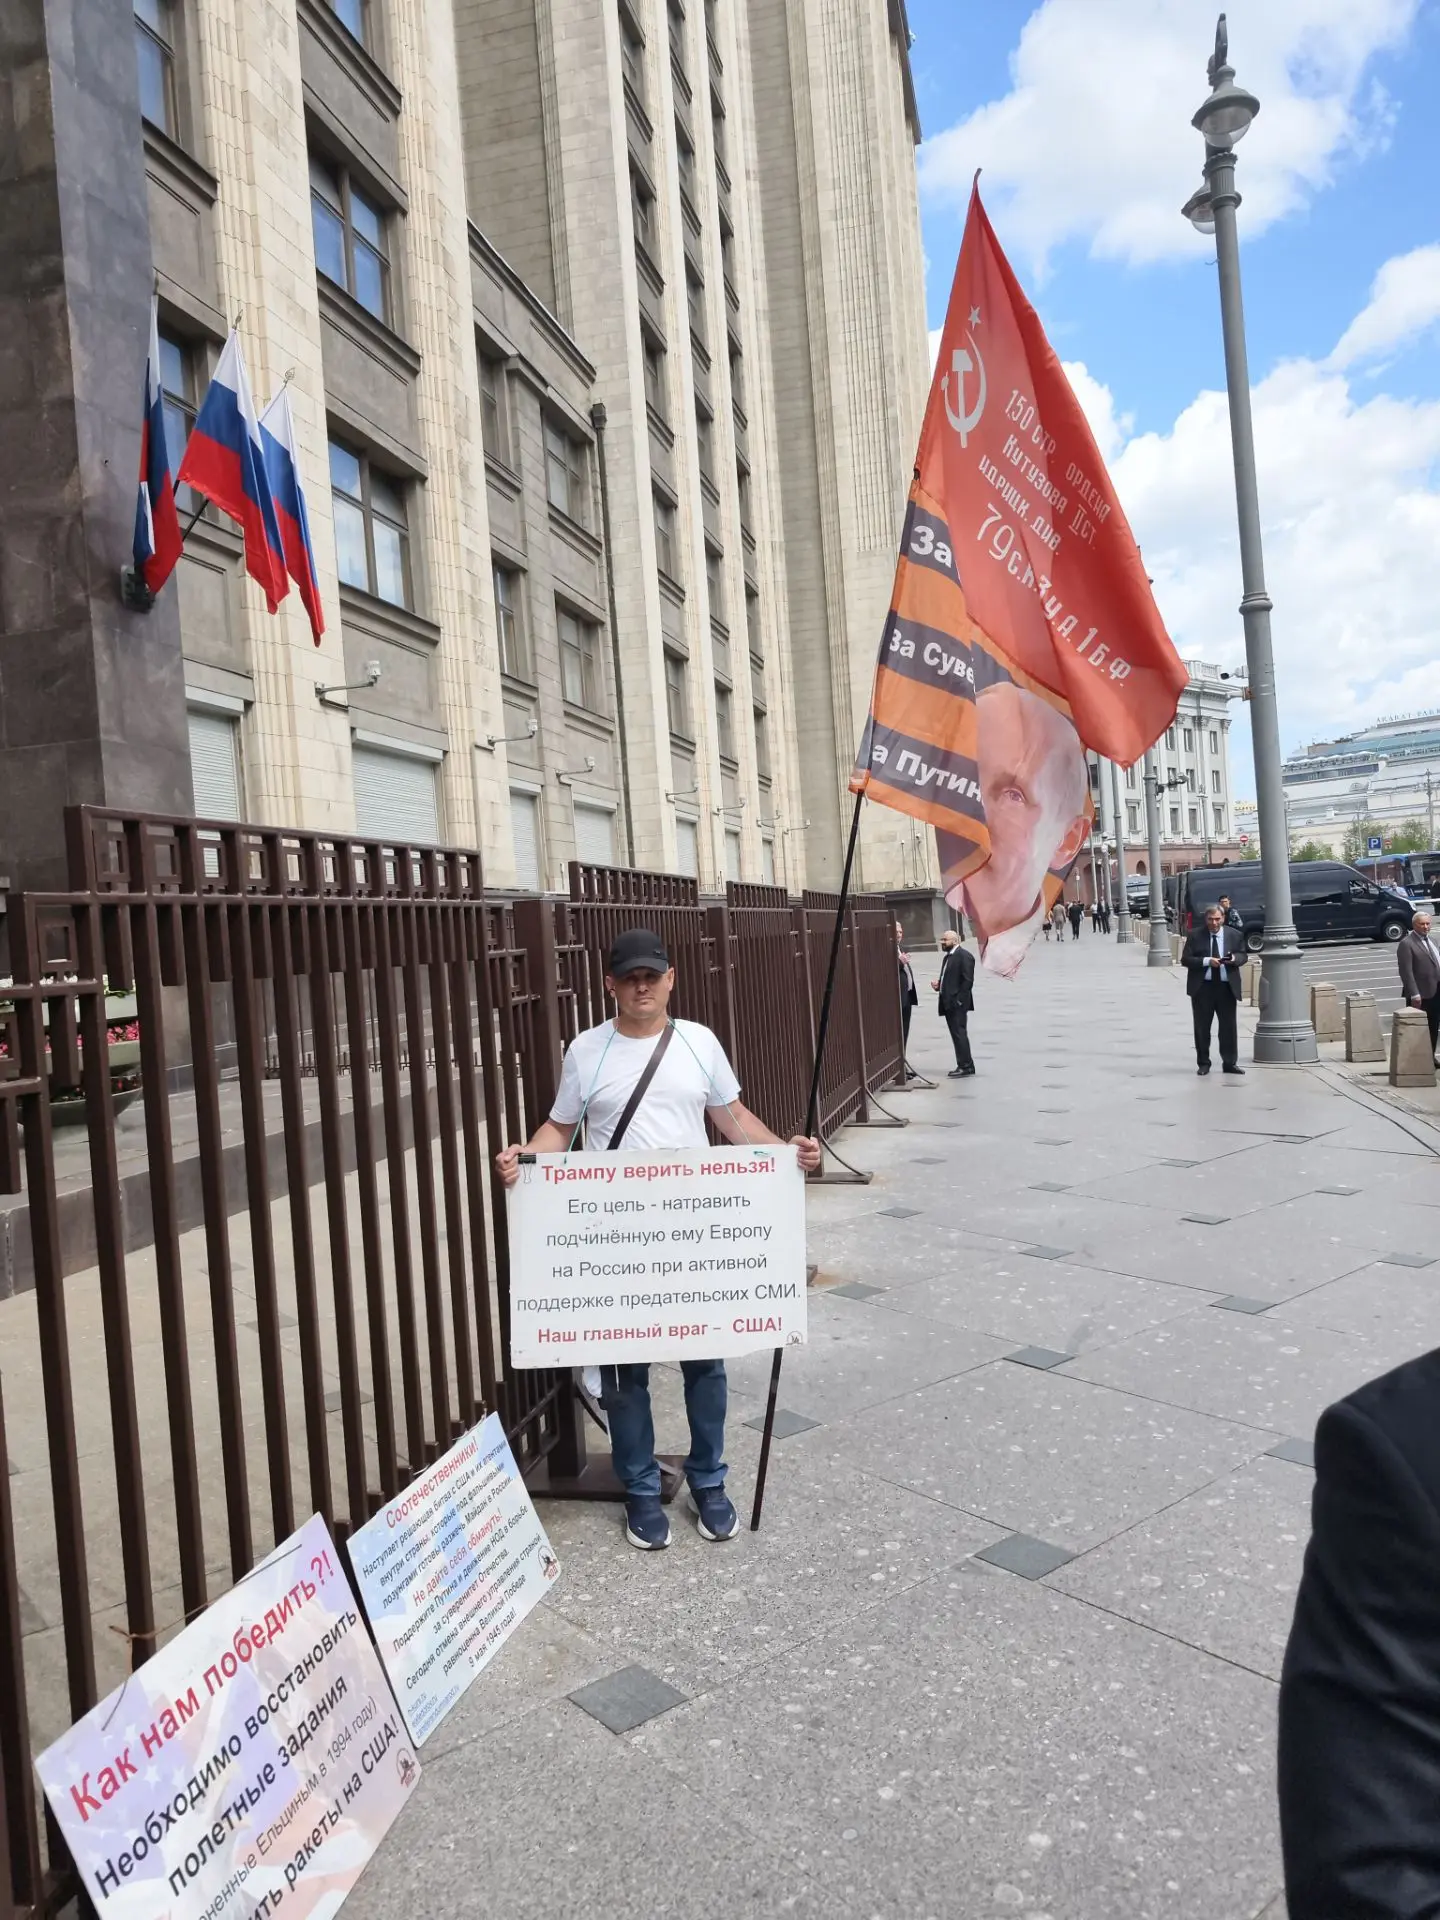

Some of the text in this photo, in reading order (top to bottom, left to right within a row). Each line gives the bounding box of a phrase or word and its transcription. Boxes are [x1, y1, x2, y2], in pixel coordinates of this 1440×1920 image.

[1005, 389, 1034, 430] 150
[910, 525, 952, 568] За
[541, 1157, 775, 1185] Трампу верить нельзя!
[568, 1198, 598, 1215] Его
[603, 1200, 646, 1216] цель
[662, 1195, 751, 1213] натравить
[546, 1224, 773, 1249] подчинённую ему Европу
[552, 1253, 768, 1278] на Россию при активной
[517, 1283, 801, 1313] поддержке предательских СМИ.
[538, 1328, 577, 1344] Наш
[583, 1323, 663, 1342] главный
[668, 1324, 709, 1341] враг
[732, 1316, 782, 1334] США!
[362, 1539, 399, 1579] Наступает
[398, 1507, 434, 1547] решающая
[432, 1490, 452, 1512] битва
[454, 1471, 471, 1490] США
[469, 1467, 476, 1478] и
[474, 1460, 484, 1473] их
[385, 1435, 479, 1528] Соотечественники!
[379, 1557, 405, 1587] внутри
[429, 1507, 457, 1537] которые
[455, 1496, 469, 1513] под
[382, 1475, 514, 1609] лозунгами готовы разжечь Майдан в России.
[392, 1504, 528, 1653] Поддержите Путина и движение НОД в борьбе
[412, 1507, 503, 1607] Не дайте себя обмануть!
[405, 1653, 436, 1690] Сегодня
[434, 1626, 460, 1657] отмена
[457, 1593, 488, 1631] внешнего
[486, 1557, 520, 1601] управления
[518, 1532, 542, 1561] страной
[432, 1548, 510, 1635] за суверенитет Отечества.
[442, 1573, 526, 1676] равноценна Великой Победе
[467, 1606, 517, 1668] 9 мая 1945 года!
[69, 1551, 333, 1822] Как нам победить?!
[94, 1612, 357, 1898] Необходимо восстановить
[168, 1676, 347, 1896] полетные задания
[255, 1773, 319, 1856] Ельциным
[317, 1761, 328, 1778] в
[326, 1725, 353, 1764] 1994
[351, 1695, 377, 1734] году)
[283, 1798, 343, 1892] ракеты
[342, 1771, 363, 1805] на
[360, 1713, 399, 1774] США!
